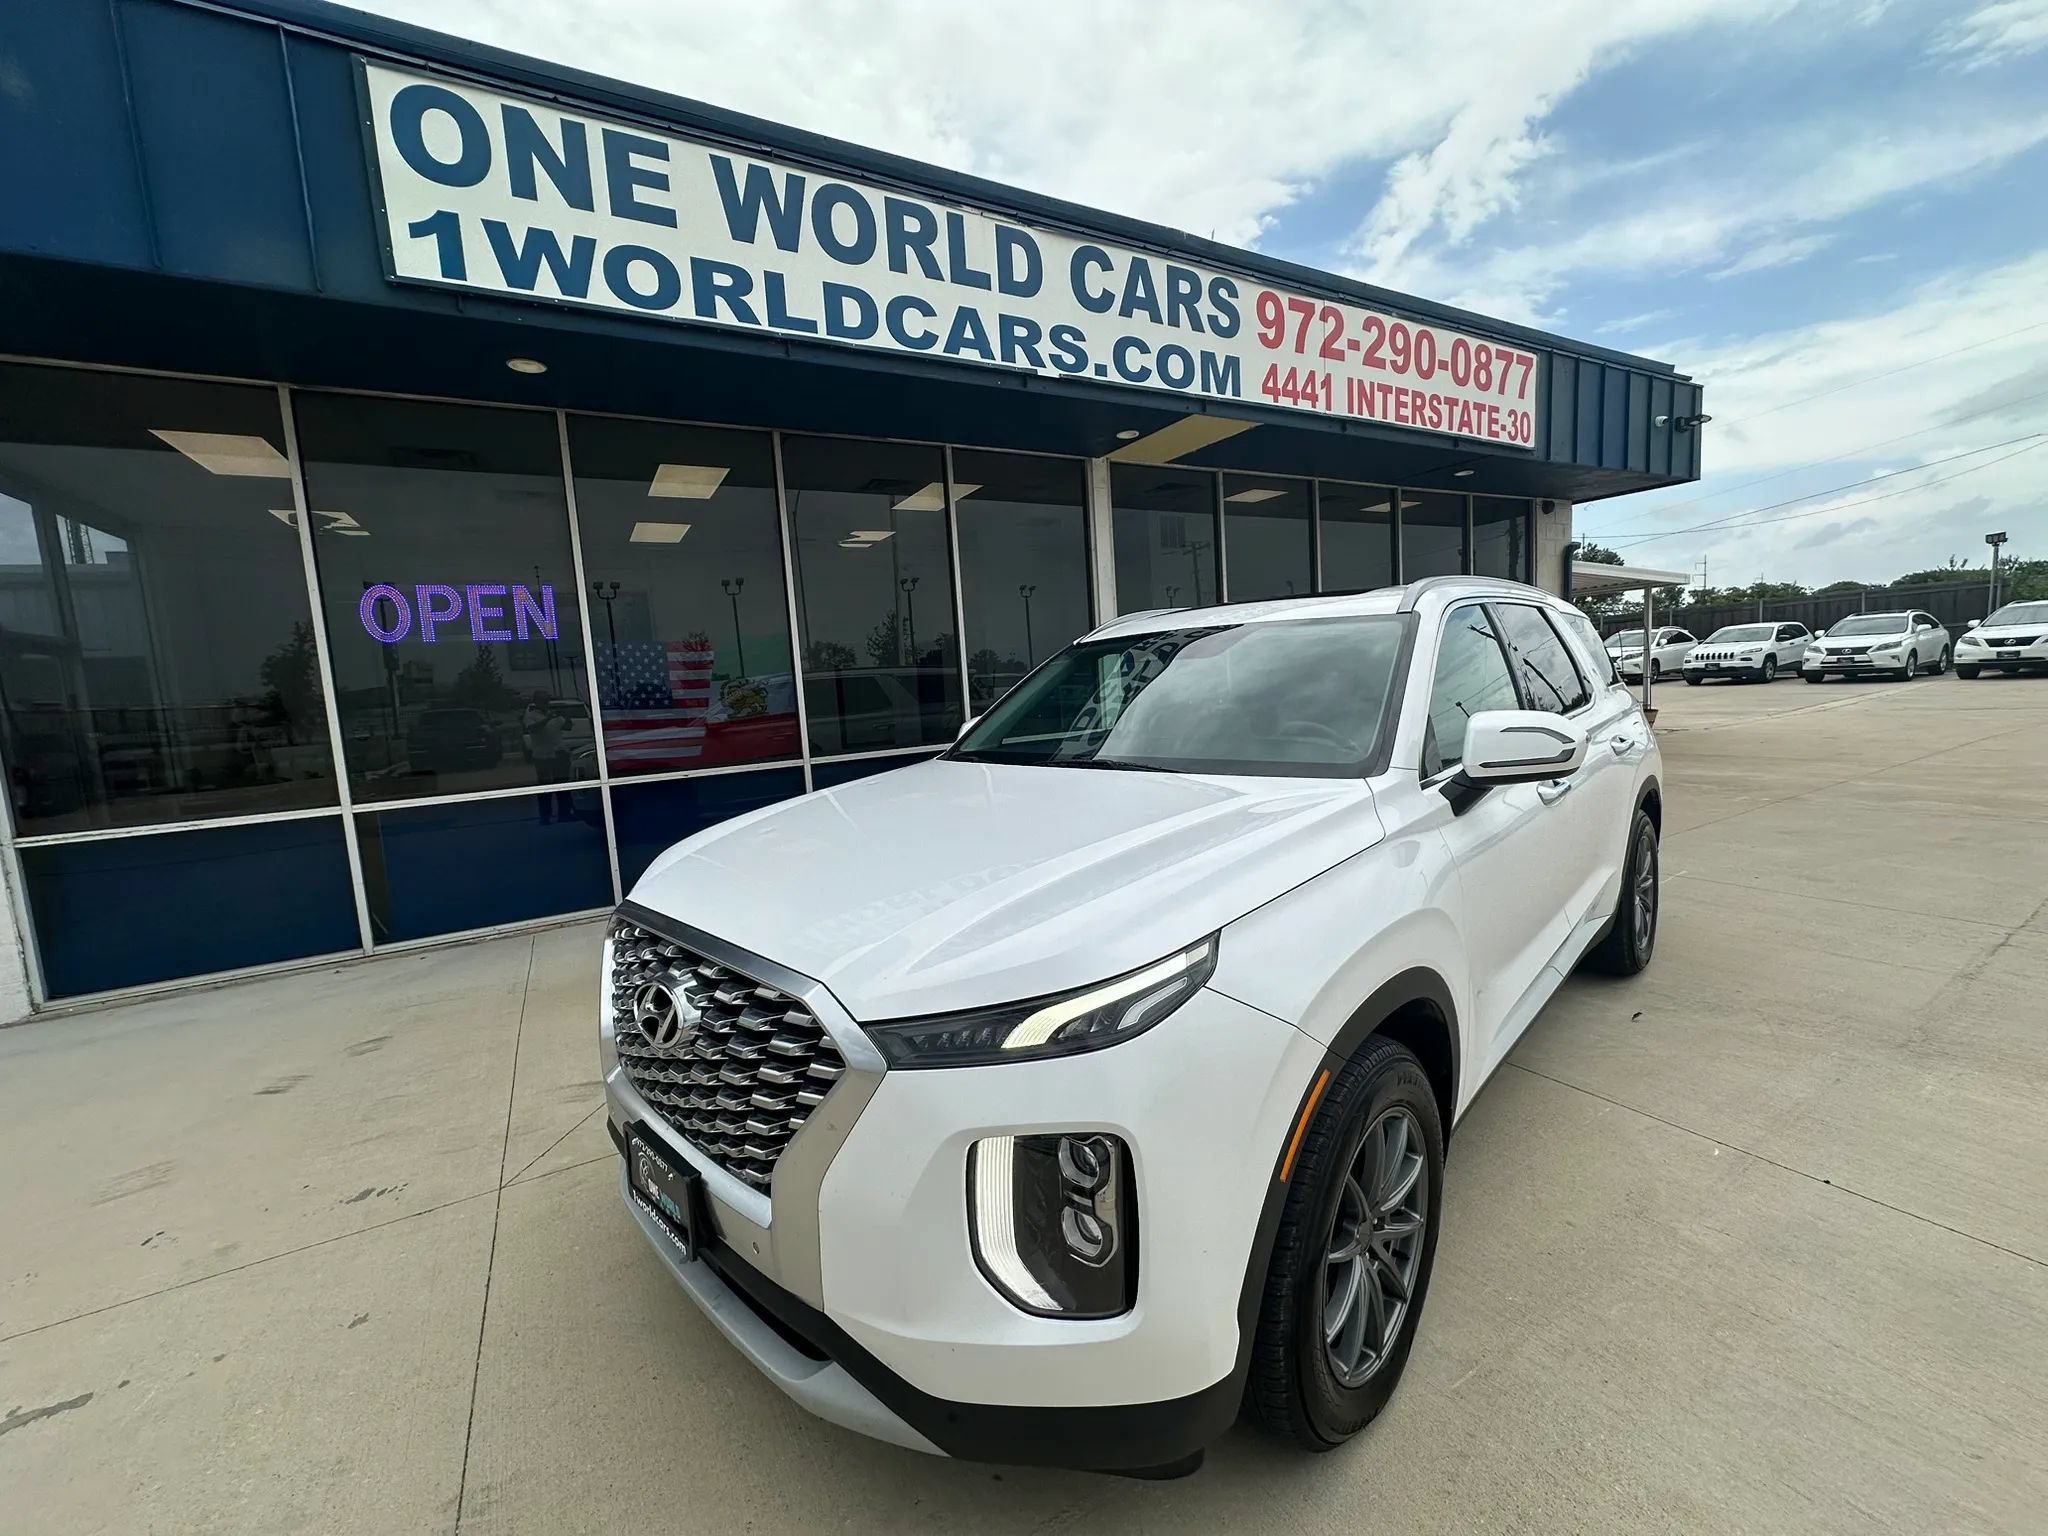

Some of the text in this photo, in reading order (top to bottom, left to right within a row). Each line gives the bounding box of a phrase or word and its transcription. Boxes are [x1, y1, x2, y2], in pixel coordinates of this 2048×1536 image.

[389, 83, 1241, 339] ONE WORLD CARS
[408, 209, 1242, 397] 1WORLDCARS.COM
[1255, 290, 1535, 400] 972-290-0877
[1262, 363, 1532, 444] 4441 INTERSTATE-30
[359, 583, 559, 643] OPEN
